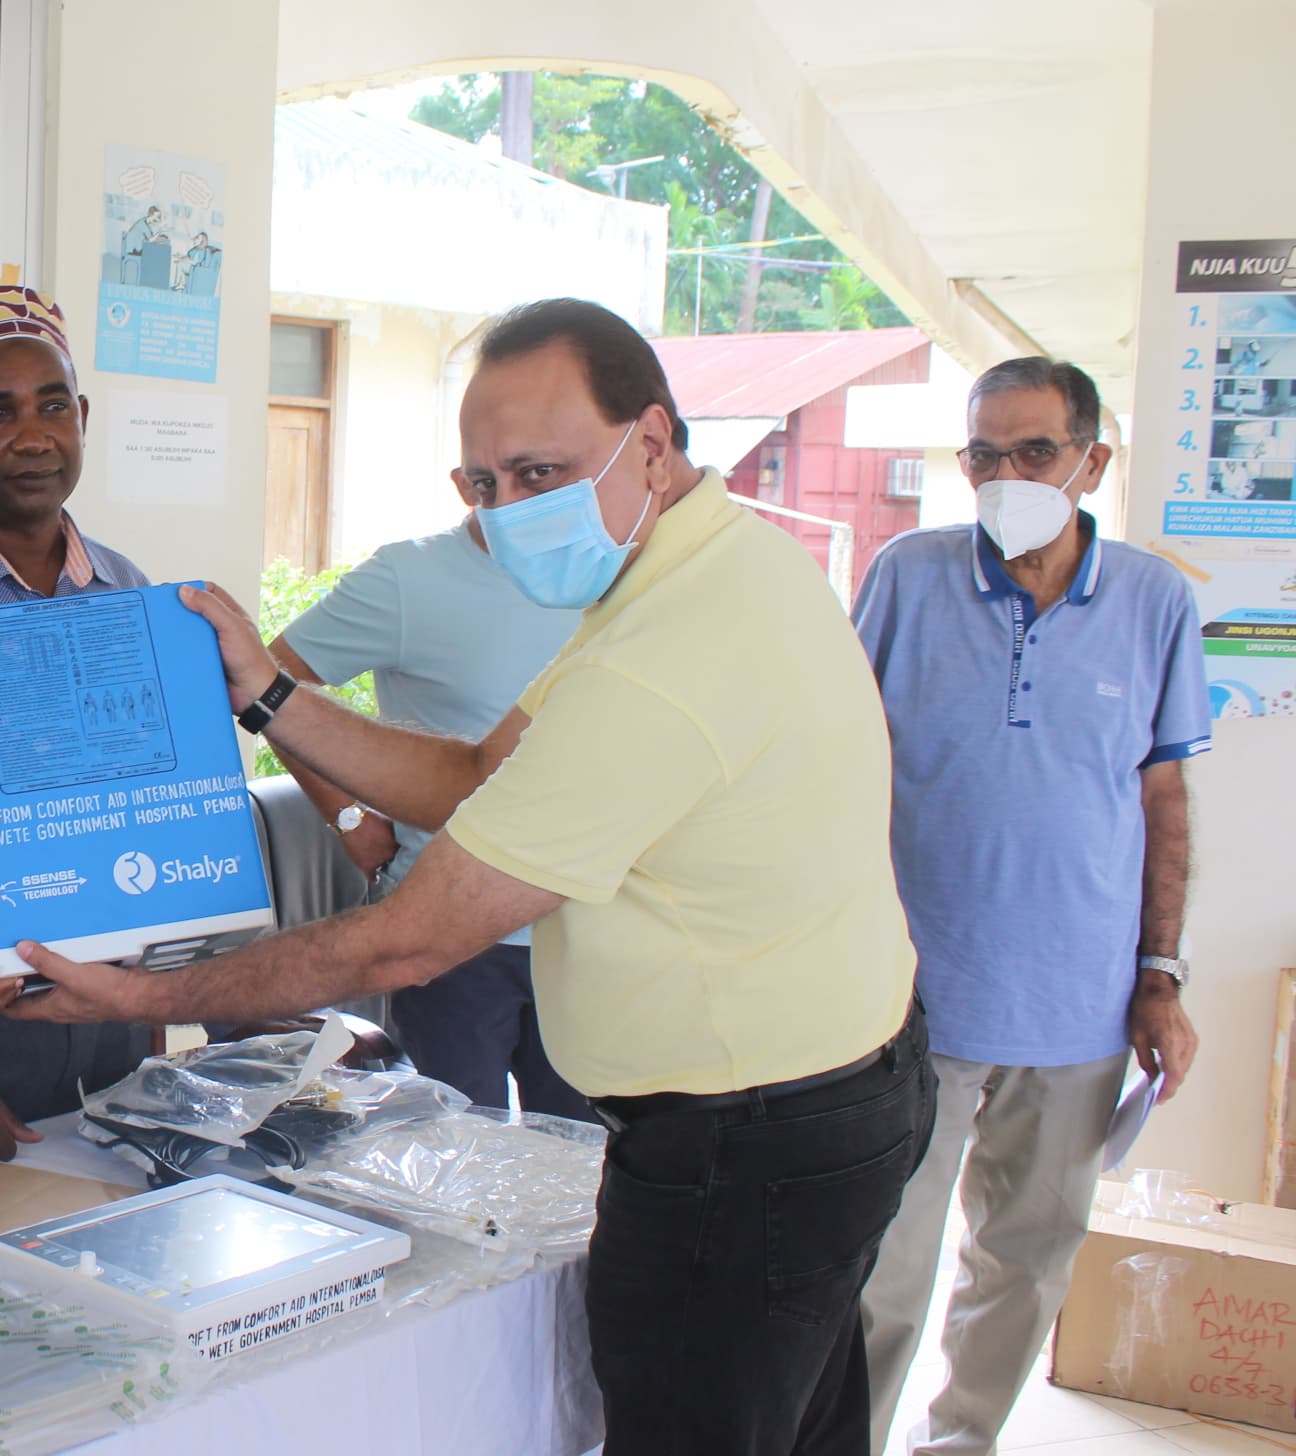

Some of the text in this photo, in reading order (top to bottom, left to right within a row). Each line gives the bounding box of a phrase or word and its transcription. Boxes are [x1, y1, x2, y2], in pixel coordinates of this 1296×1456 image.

[1190, 258, 1236, 276] NJIA
[1239, 257, 1286, 275] KUU
[1189, 305, 1208, 327] 1.
[1182, 348, 1205, 369] 2.
[1179, 390, 1201, 411] 3.
[1177, 430, 1198, 451] 4.
[1173, 473, 1195, 494] 5.
[36, 795, 101, 820] COMFORT
[108, 792, 127, 809] AID
[37, 812, 128, 841] GOVERNMENT
[135, 804, 198, 825] HOSPITAL
[204, 795, 246, 816] PEMBA
[24, 884, 80, 901] TECHNOLOGY
[209, 1287, 377, 1360] WETE GOVERNMENT HOSPITAL PEMBA
[216, 1318, 241, 1338] FROM
[244, 1302, 287, 1329] COMFORT
[289, 1295, 306, 1313] AID
